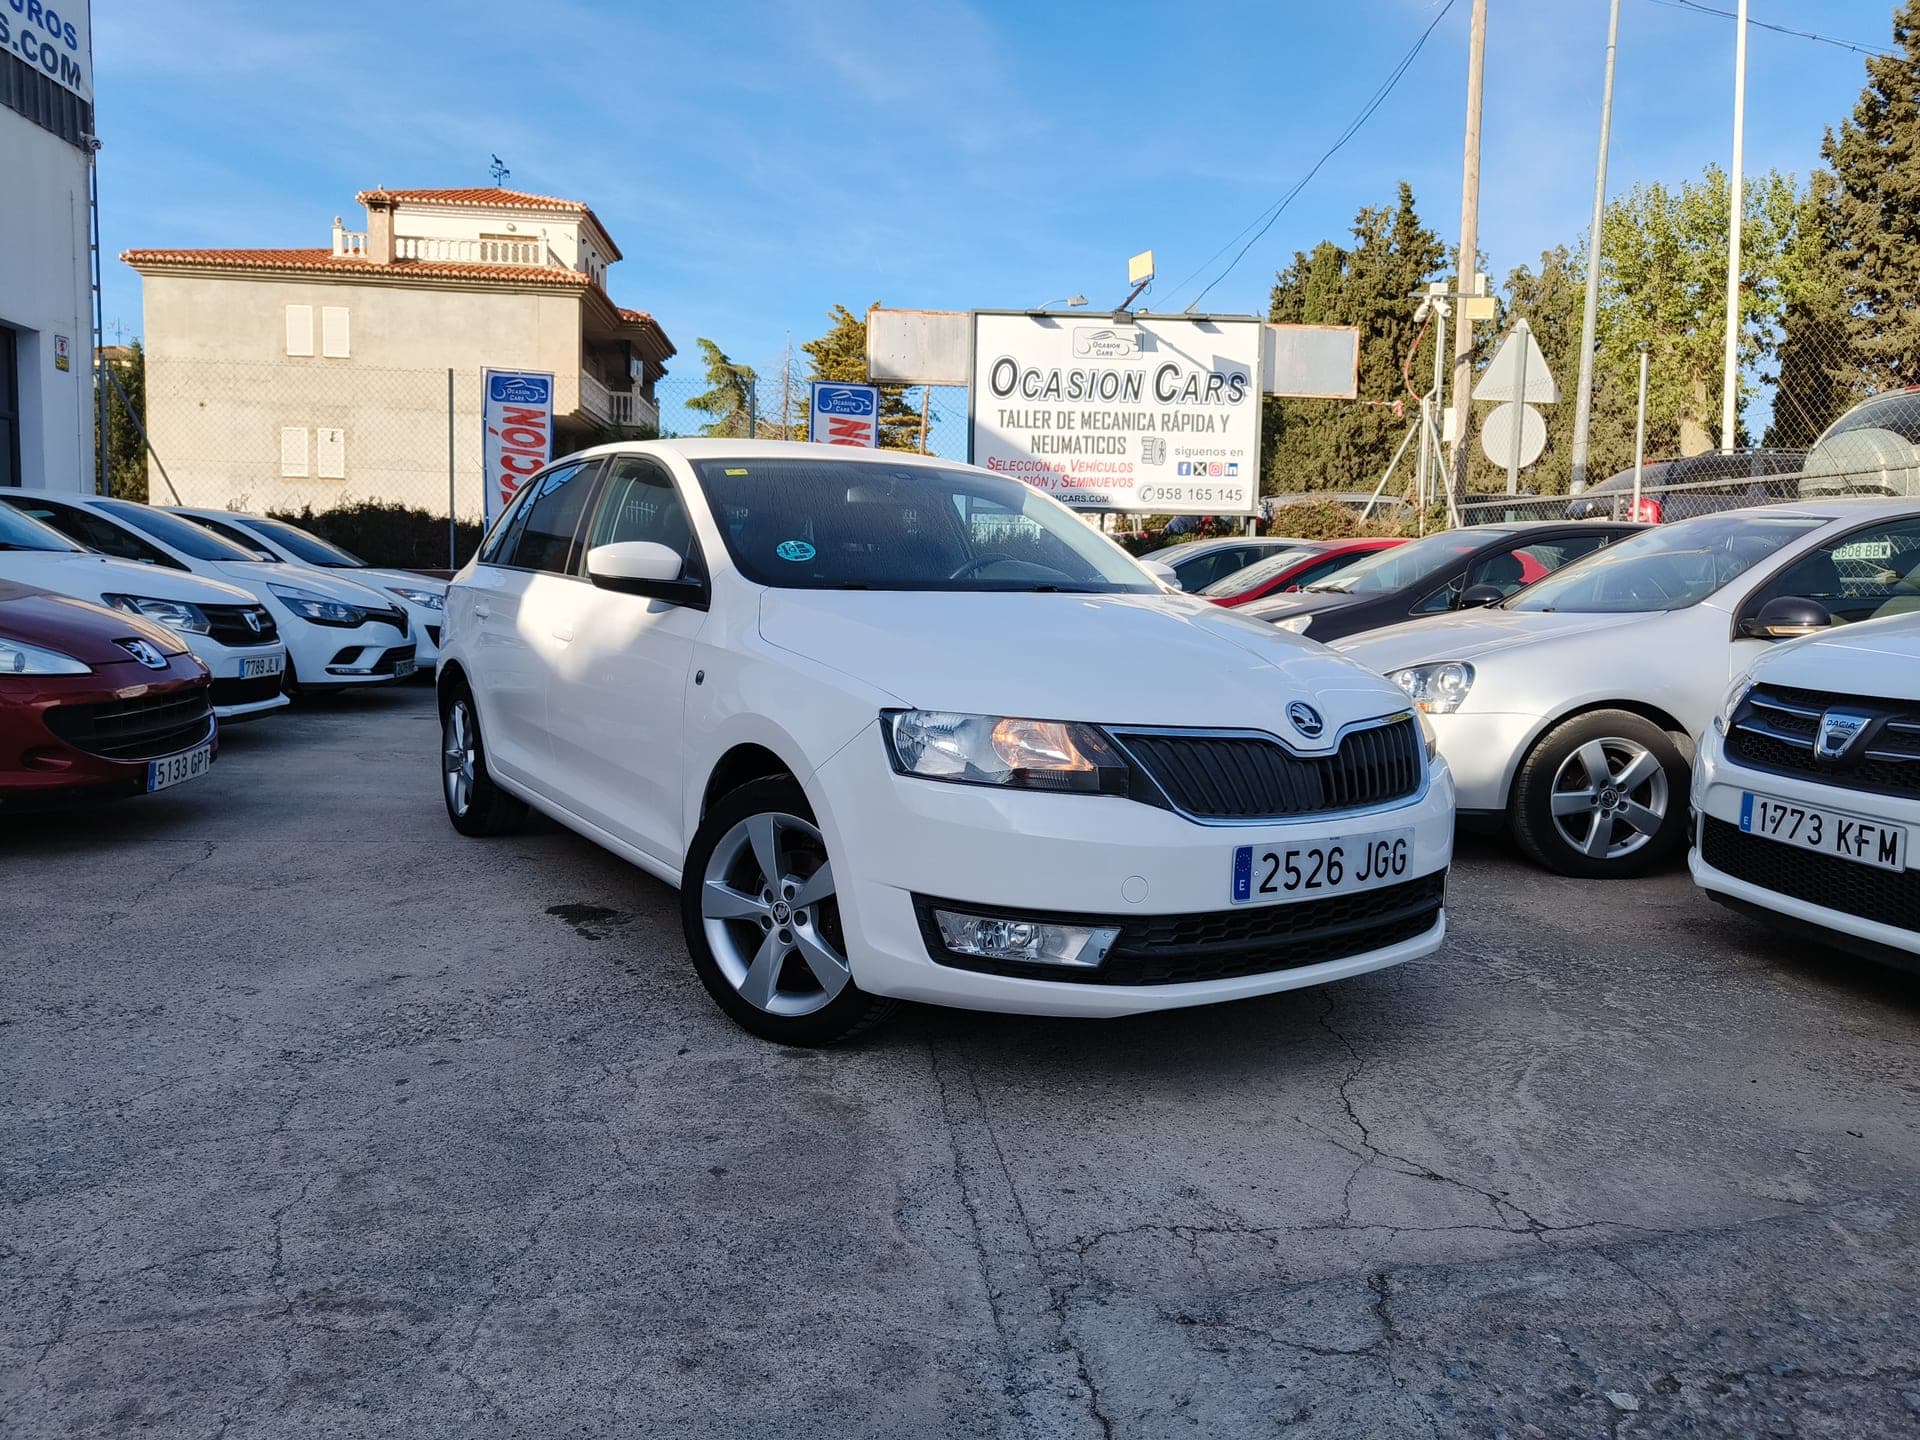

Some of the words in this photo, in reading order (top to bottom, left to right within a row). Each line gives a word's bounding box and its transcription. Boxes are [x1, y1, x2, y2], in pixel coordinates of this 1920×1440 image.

[990, 357, 1144, 402] OCASION
[1155, 362, 1248, 403] CARS
[998, 409, 1051, 430] TALLER
[1056, 411, 1075, 430] DE
[1080, 411, 1156, 432] MECANICA
[1161, 411, 1215, 433] RÁPIDA
[1219, 414, 1230, 434] Y
[1030, 435, 1127, 455] NEUMATICOS
[1230, 449, 1244, 457] en
[986, 456, 1051, 472] SELECCIÓN
[1053, 463, 1067, 473] de
[1070, 459, 1134, 473] VEHÍCULOS
[1050, 479, 1058, 490] y
[1060, 474, 1135, 489] SEMINUEVOS
[1156, 487, 1182, 500] 958
[1187, 488, 1212, 501] 165
[1217, 489, 1242, 501] 145
[158, 757, 188, 785] 5133
[190, 749, 209, 775] GPT
[1743, 815, 1750, 826] E
[1760, 801, 1824, 846] 1773
[1836, 819, 1899, 866] KFM
[1239, 879, 1246, 891] E
[1259, 846, 1345, 894] 2526
[1355, 838, 1407, 882] JGG
